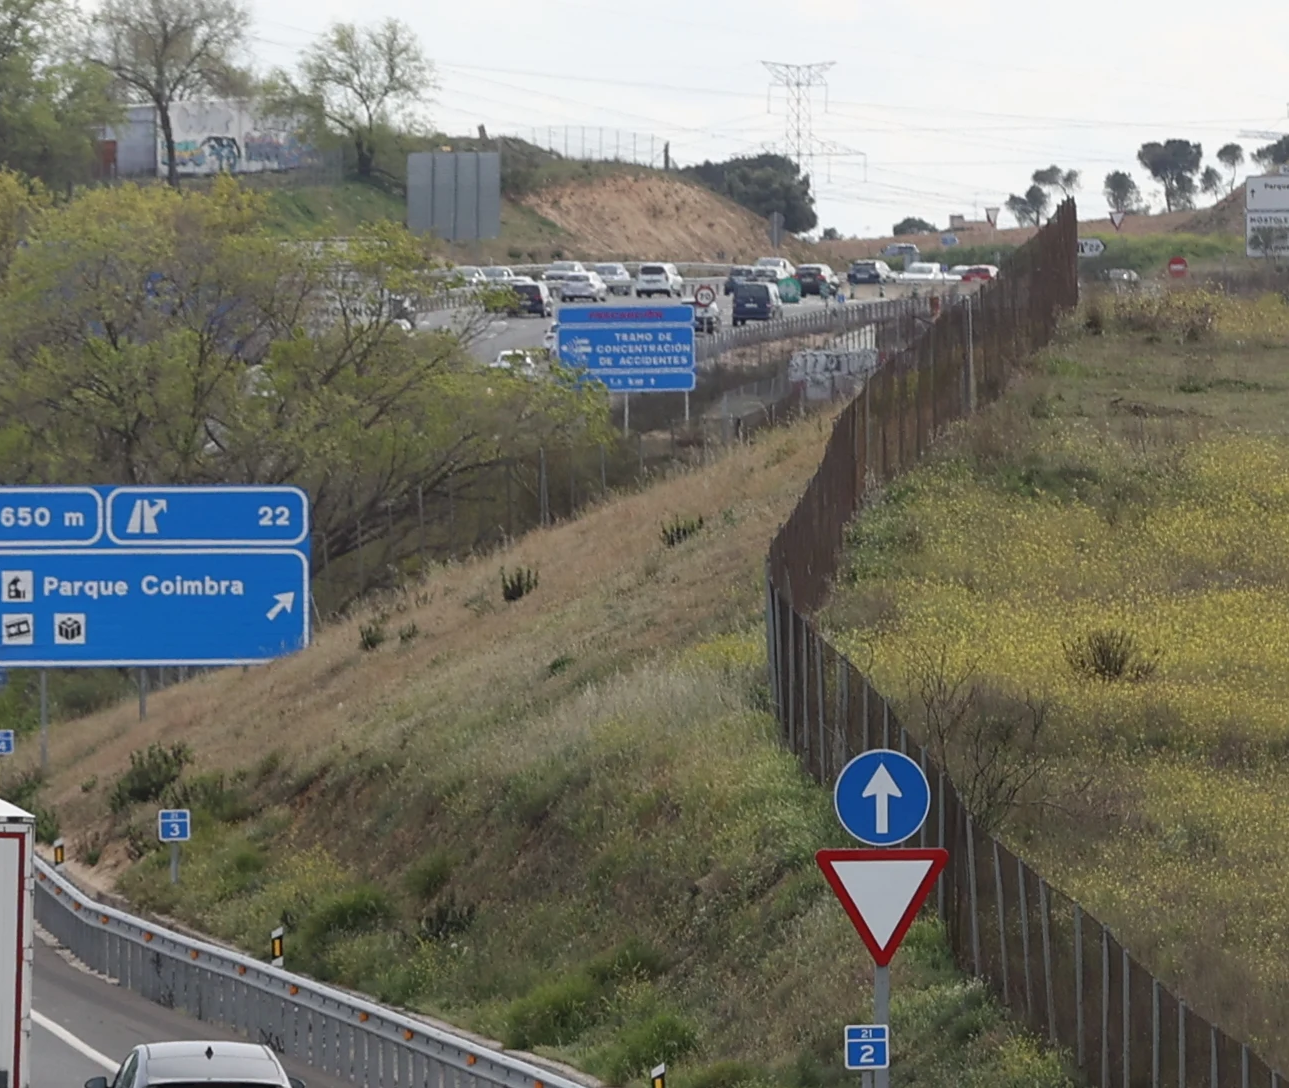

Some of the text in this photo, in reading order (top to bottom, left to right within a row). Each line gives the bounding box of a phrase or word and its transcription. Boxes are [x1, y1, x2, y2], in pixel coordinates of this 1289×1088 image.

[614, 332, 672, 341] TRAMO DE
[596, 342, 691, 354] CONCENTRACIÓN
[599, 355, 688, 366] DE ACCIDENTES
[0, 507, 84, 527] 650 m
[258, 506, 290, 525] 22
[42, 575, 244, 599] Parque Coimbra
[169, 823, 180, 836] 3
[861, 1029, 872, 1039] 21
[859, 1045, 875, 1063] 2
